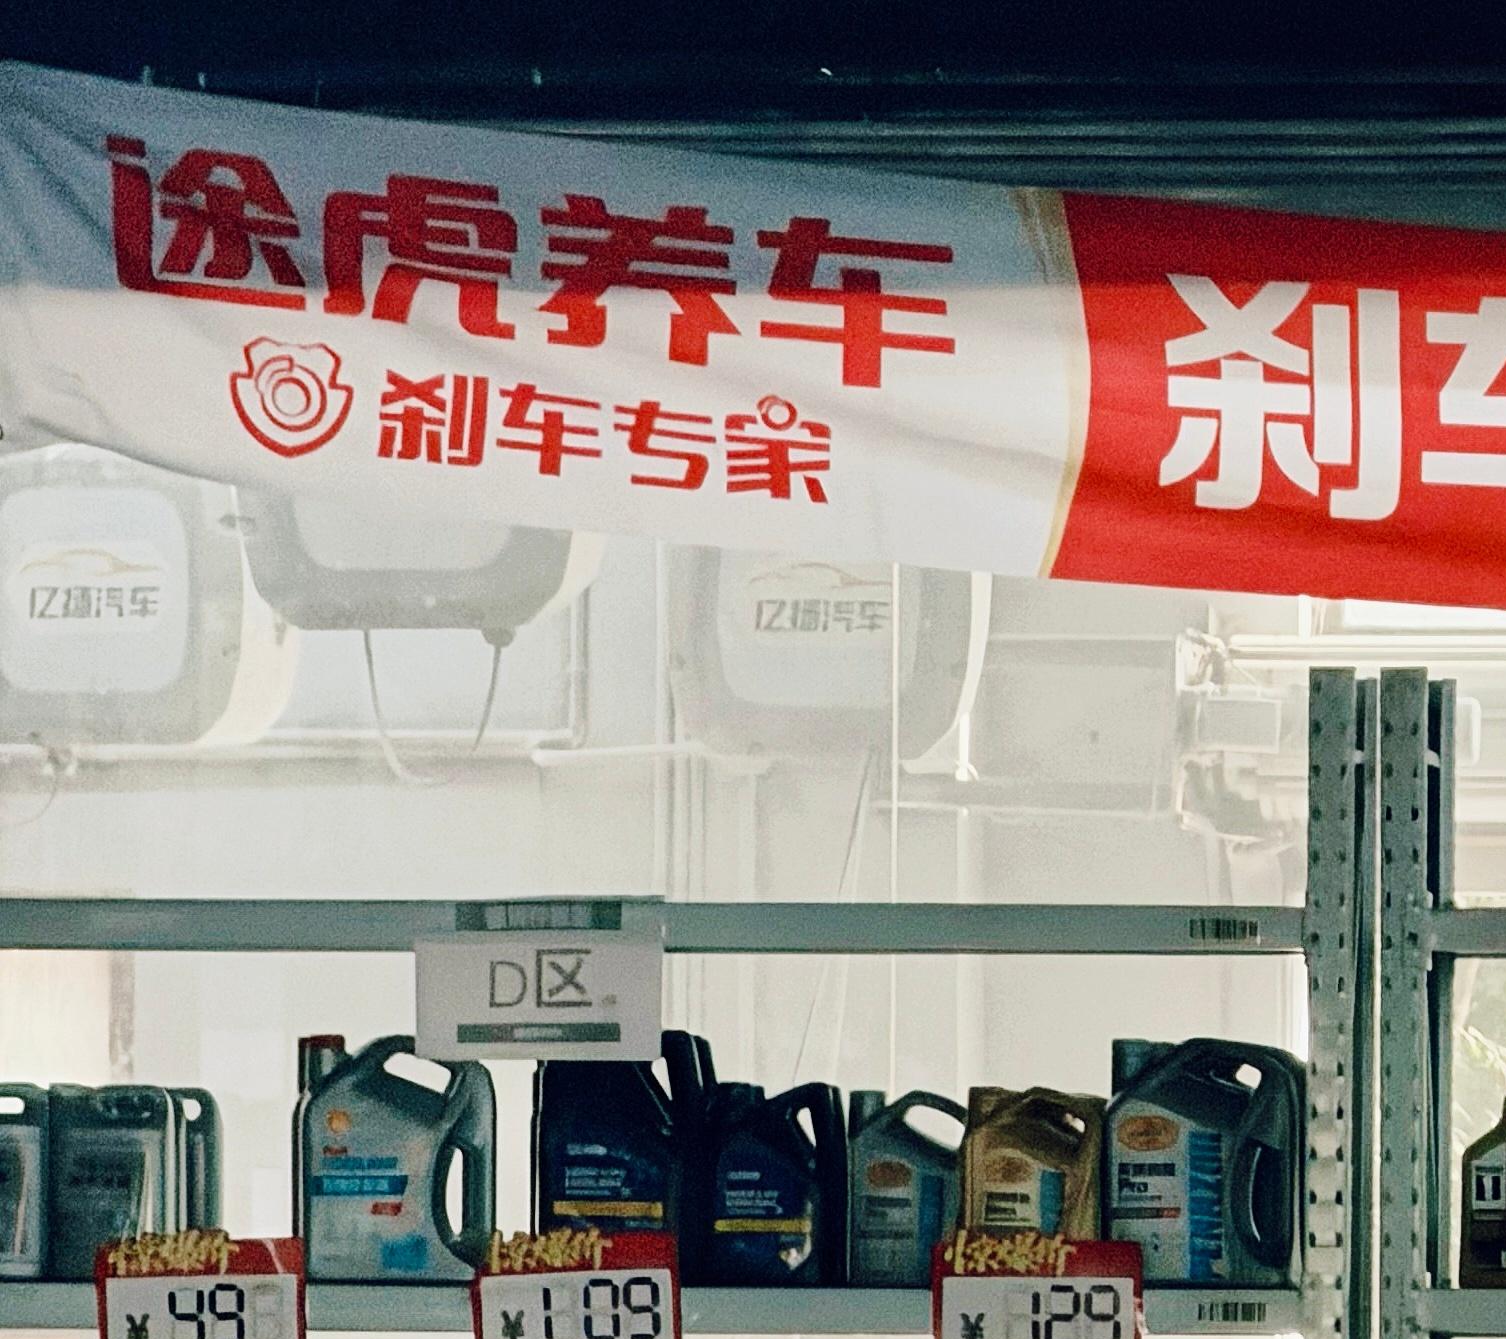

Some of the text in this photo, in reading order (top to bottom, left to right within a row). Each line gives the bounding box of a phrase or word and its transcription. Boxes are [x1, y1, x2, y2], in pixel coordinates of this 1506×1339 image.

[106, 136, 956, 388] 途虎养车
[378, 368, 832, 504] 刹车专家
[489, 948, 593, 1008] D区
